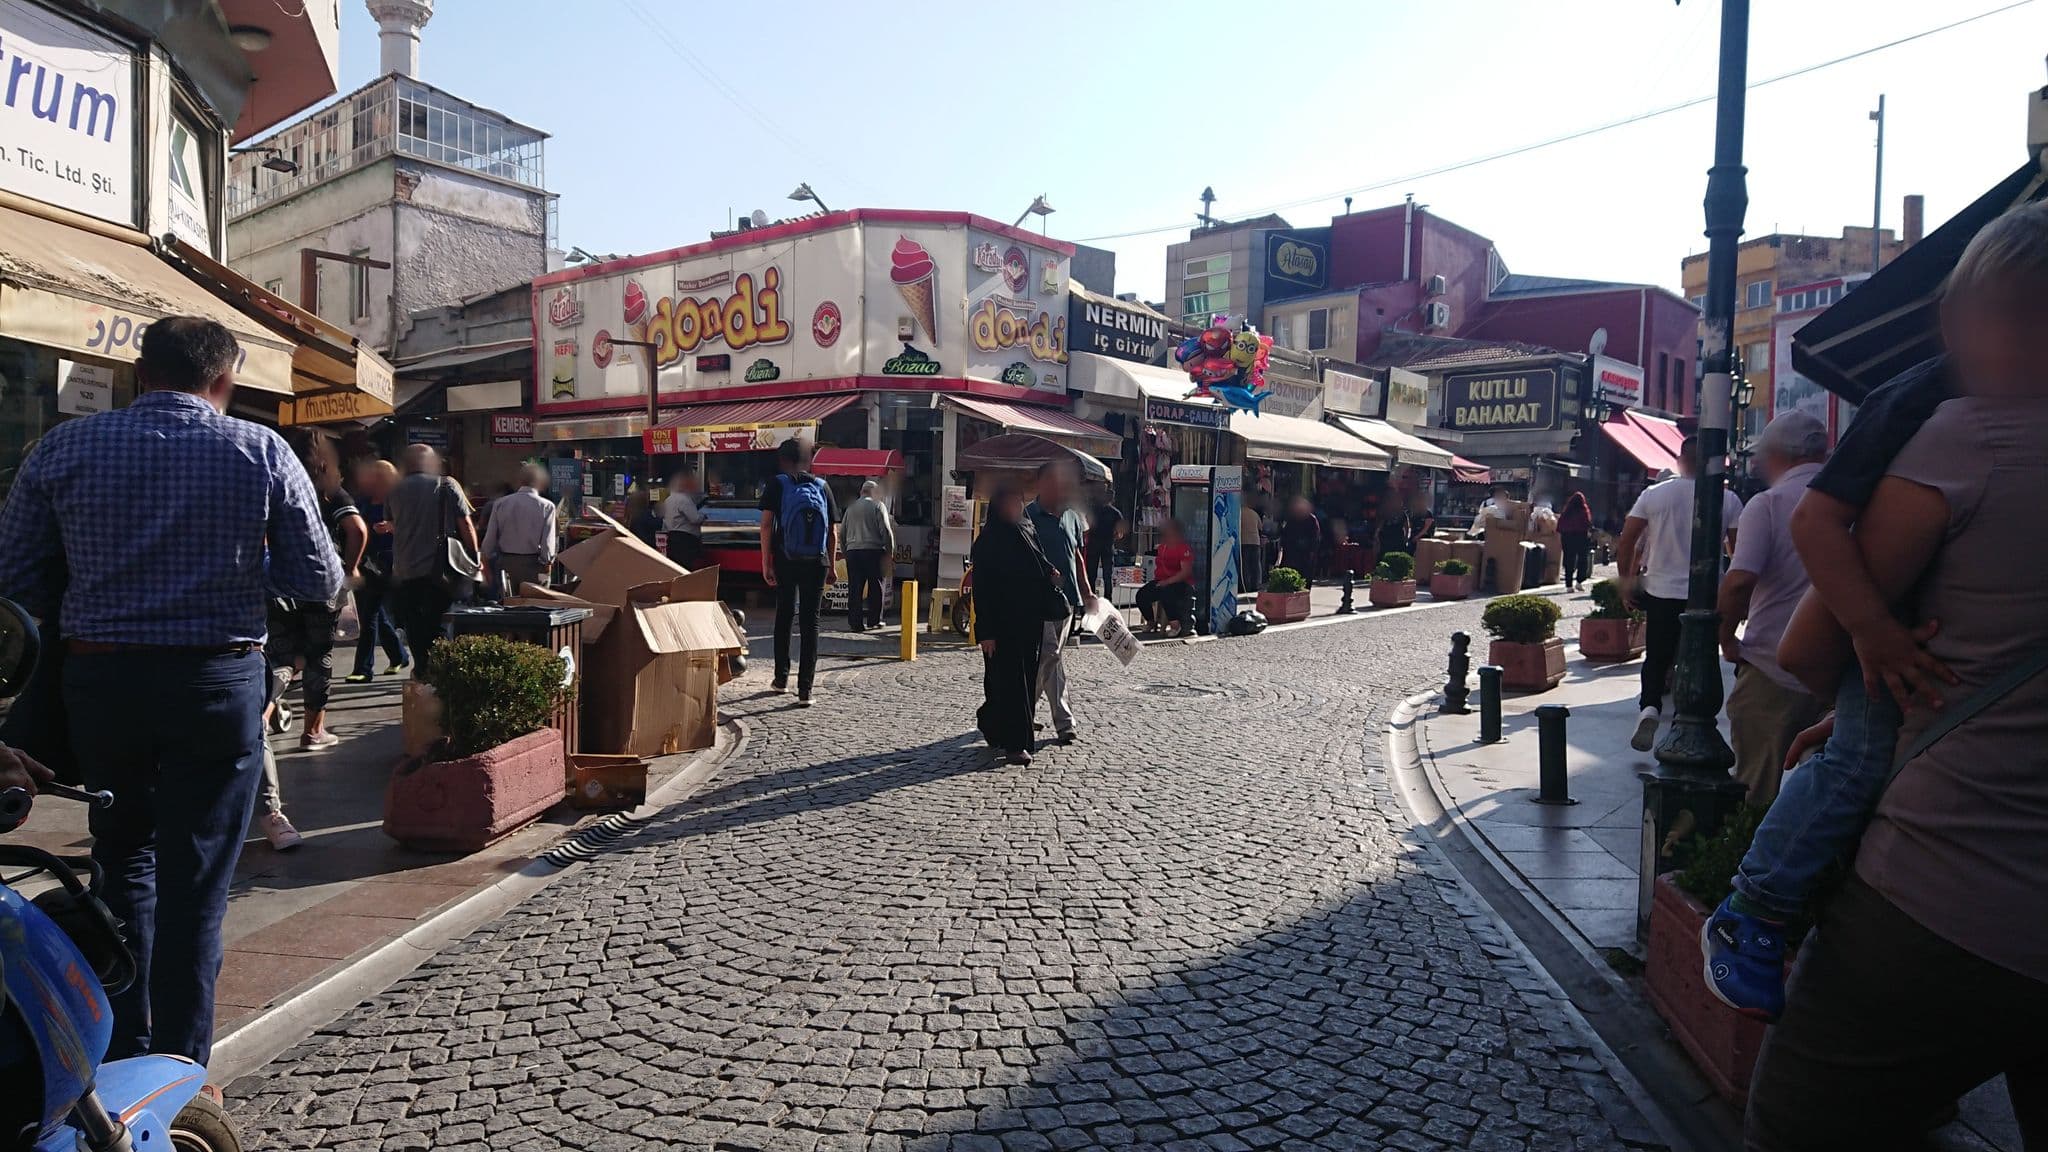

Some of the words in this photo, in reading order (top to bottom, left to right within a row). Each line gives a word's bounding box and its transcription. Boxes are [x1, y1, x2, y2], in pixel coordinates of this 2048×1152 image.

[0, 35, 116, 143] rum
[17, 147, 49, 174] Tic.
[55, 160, 87, 186] Ltd.
[91, 172, 116, 195] Şti.
[1086, 303, 1164, 340] NERMİN
[1094, 329, 1109, 352] İÇ
[1115, 337, 1155, 358] GİYİM
[1469, 378, 1528, 401] KUTLU
[1455, 402, 1541, 426] BAHARAT
